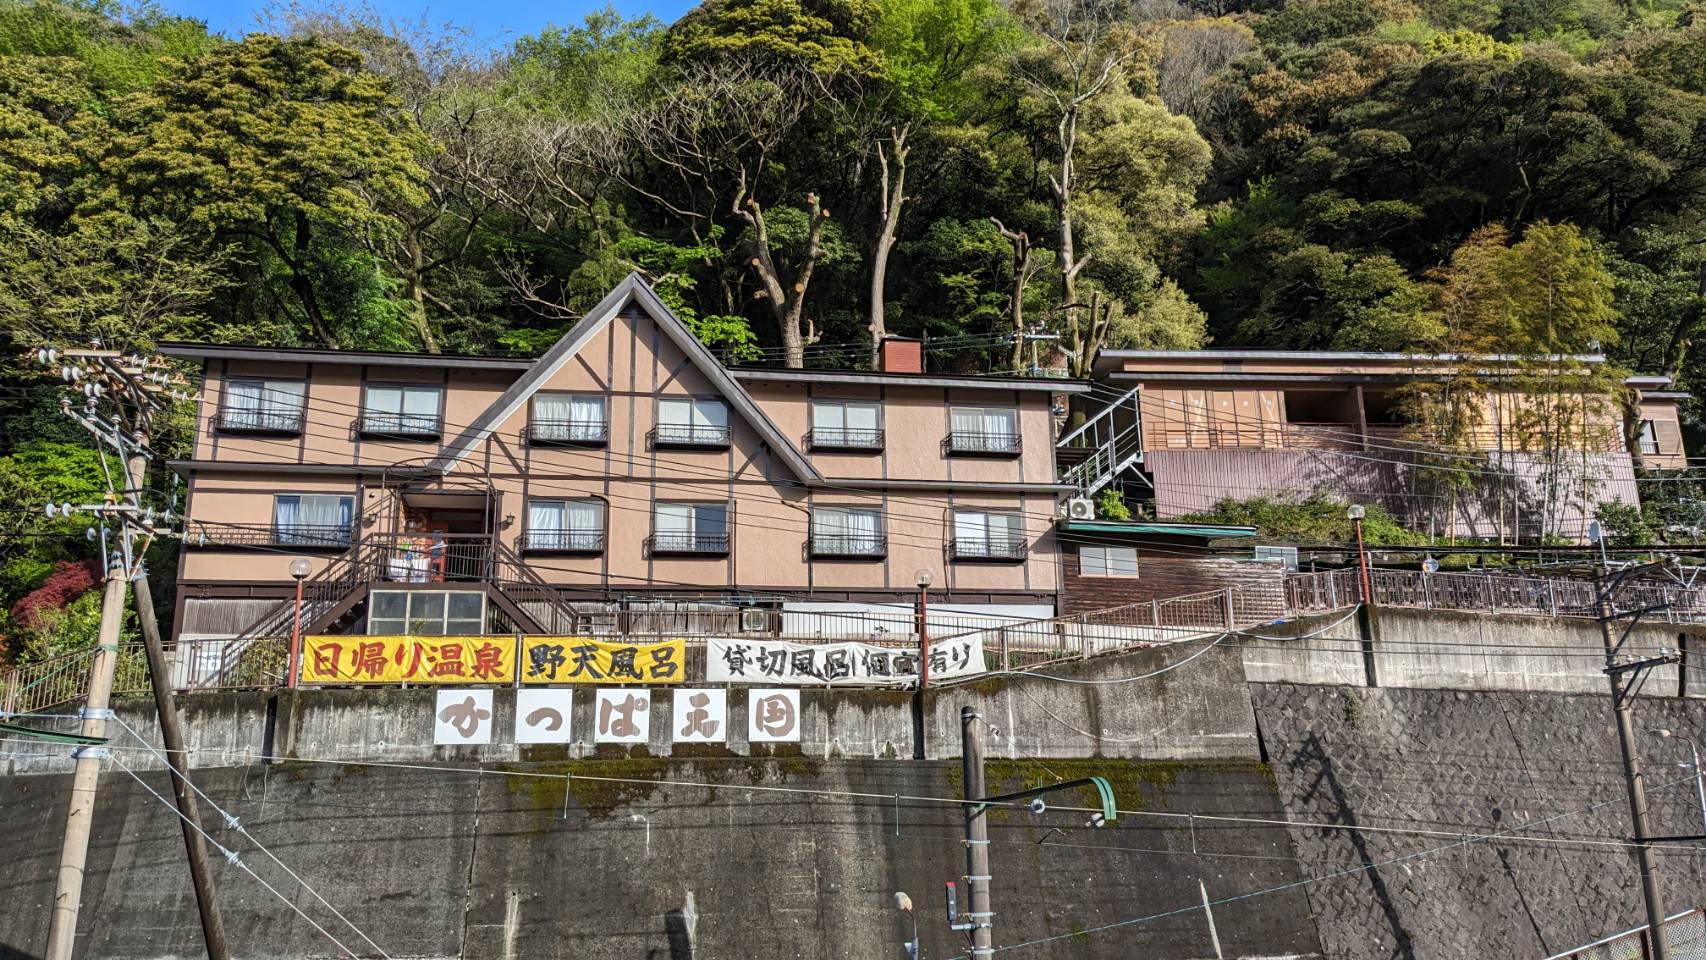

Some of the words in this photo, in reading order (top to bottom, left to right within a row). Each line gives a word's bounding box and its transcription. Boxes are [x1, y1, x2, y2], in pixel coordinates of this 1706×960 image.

[313, 641, 505, 680] 日帰り温泉
[527, 643, 678, 680] 野天風呂
